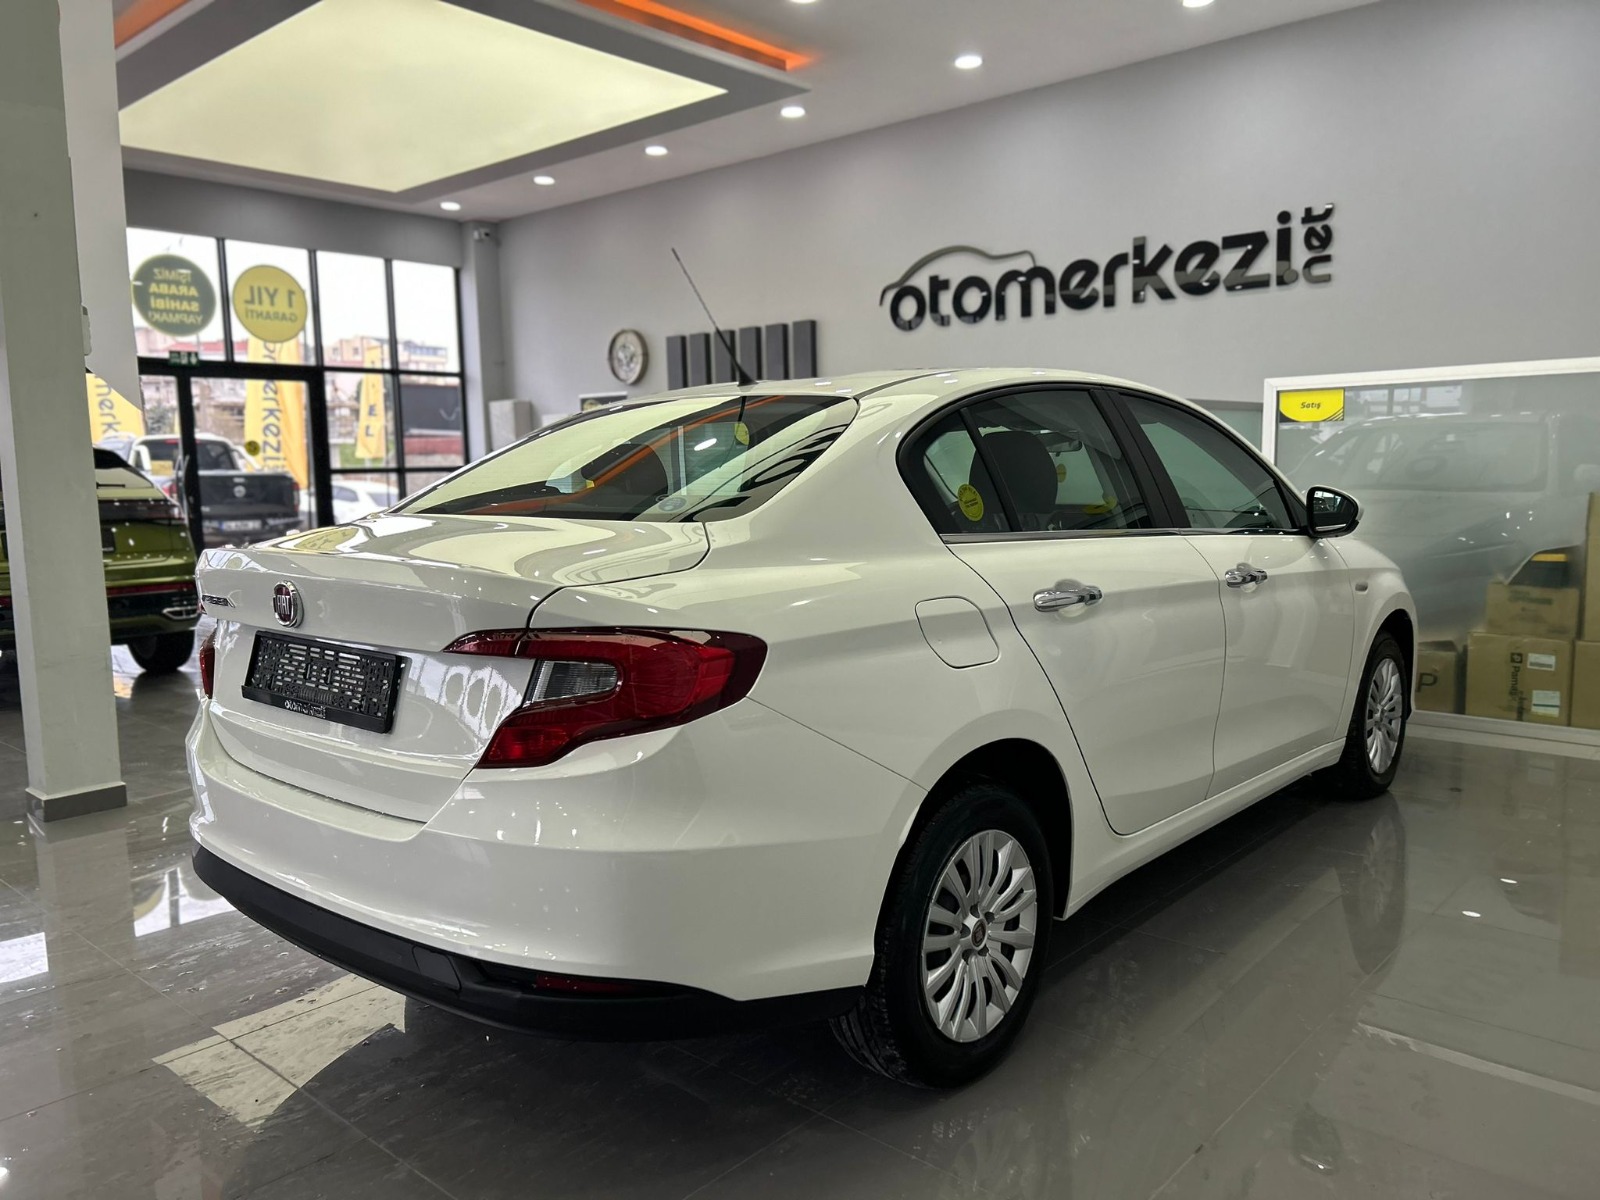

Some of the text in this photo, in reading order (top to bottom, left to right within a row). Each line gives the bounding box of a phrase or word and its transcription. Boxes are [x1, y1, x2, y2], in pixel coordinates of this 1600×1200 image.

[1301, 202, 1334, 284] net
[1300, 401, 1322, 410] Satış
[276, 594, 291, 615] FIAT
